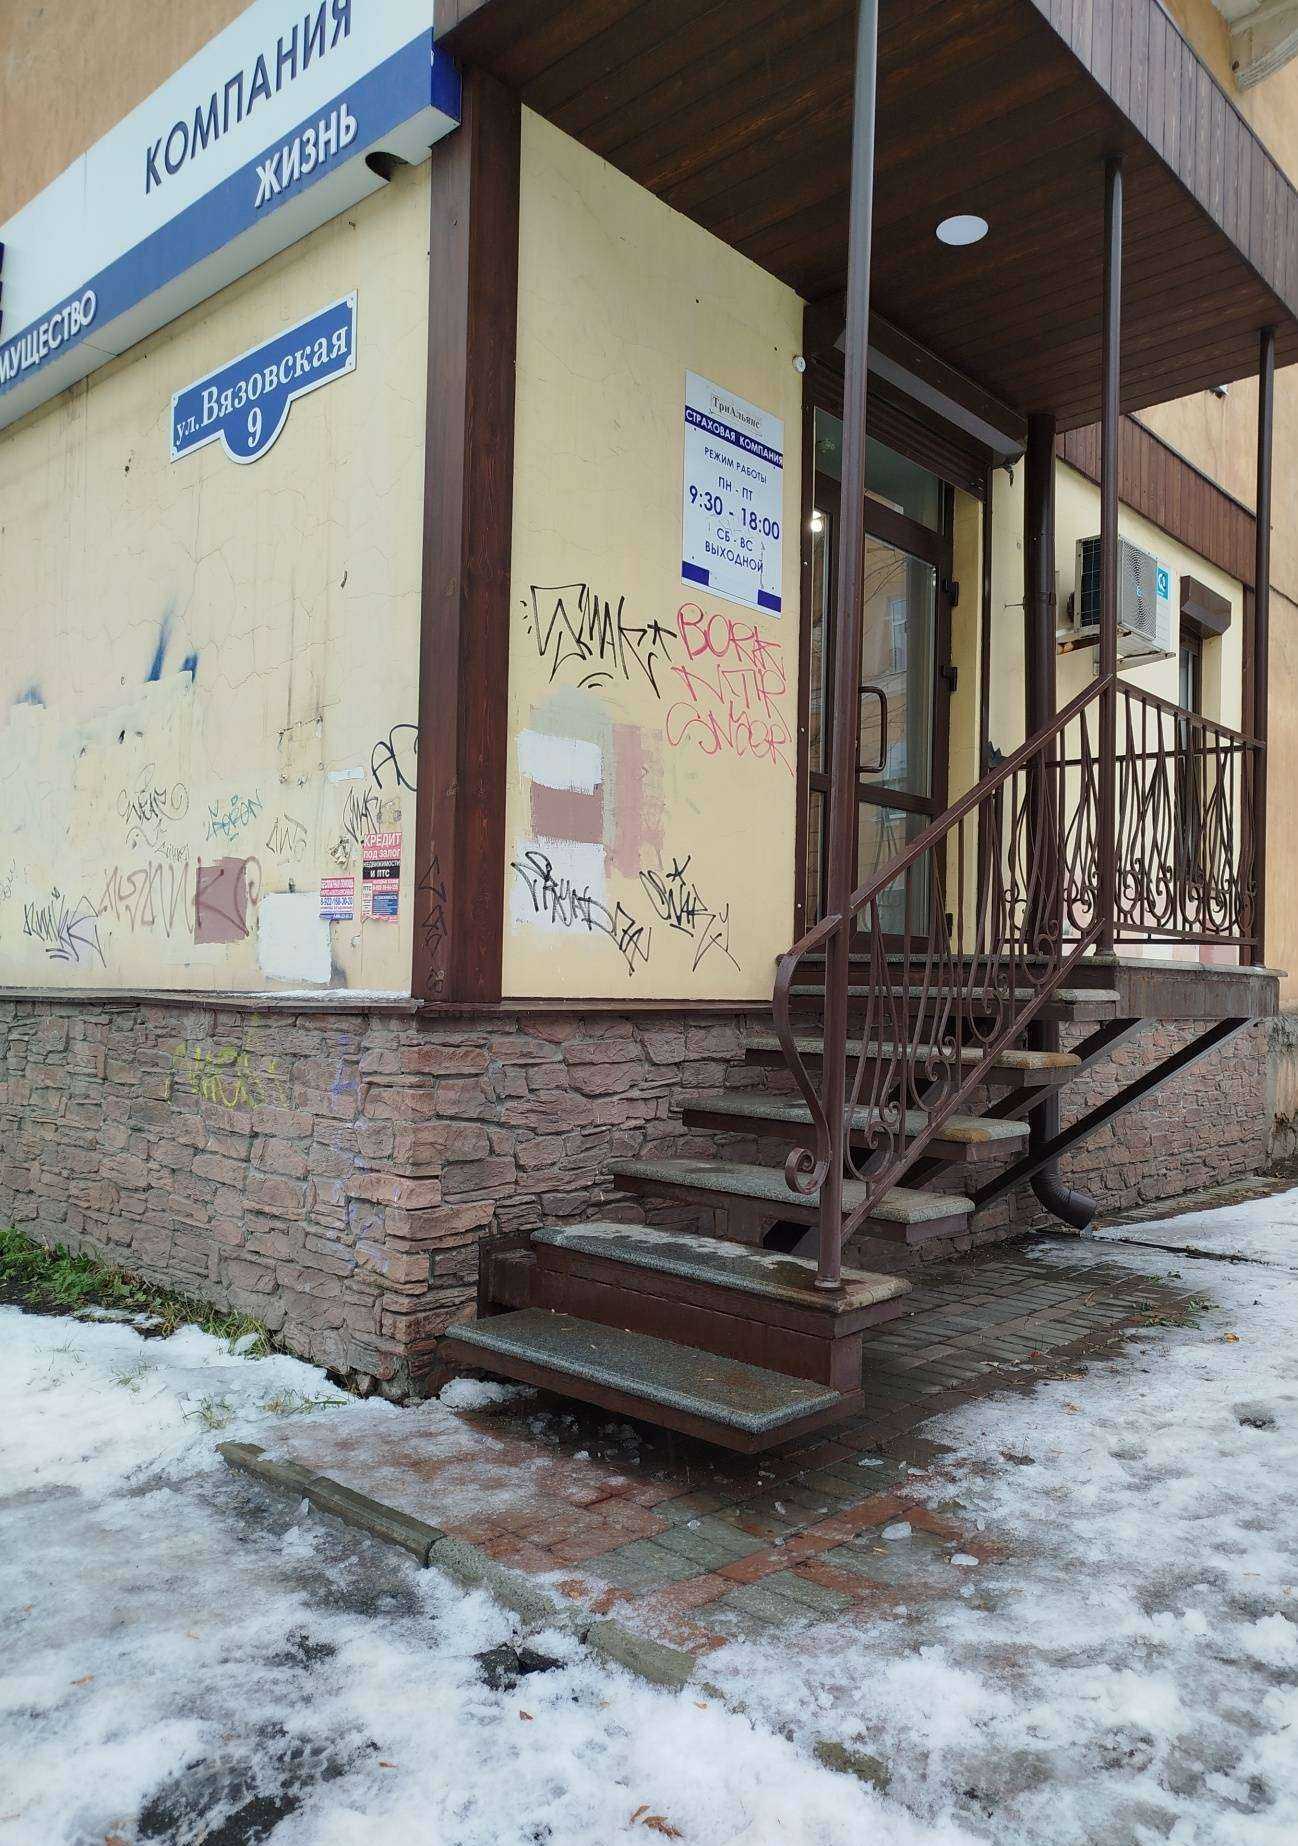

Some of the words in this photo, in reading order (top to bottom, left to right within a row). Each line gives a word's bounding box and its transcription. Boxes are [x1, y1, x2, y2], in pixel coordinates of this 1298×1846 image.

[145, 0, 351, 194] КОМПАНИЯ
[254, 103, 358, 208] ЖИЗНЬ
[176, 416, 200, 446] ул.
[201, 326, 348, 427] Вязовская
[247, 407, 262, 447] 9
[685, 410, 736, 442] СТРАХОВАЯ
[739, 436, 783, 466] КОМПАНИЯ
[704, 447, 735, 468] РЕЖИМ
[736, 462, 767, 484] РАБОТЫ
[718, 476, 732, 492] ПН
[742, 487, 753, 501] ПТ
[689, 485, 723, 515] 9:30
[741, 507, 780, 540] 18:00
[705, 541, 764, 573] ВЫХОДНОЙ
[716, 528, 731, 543] СБ
[740, 537, 753, 551] ВС
[363, 832, 401, 848] КРЕДИТ
[376, 869, 390, 877] ПТС
